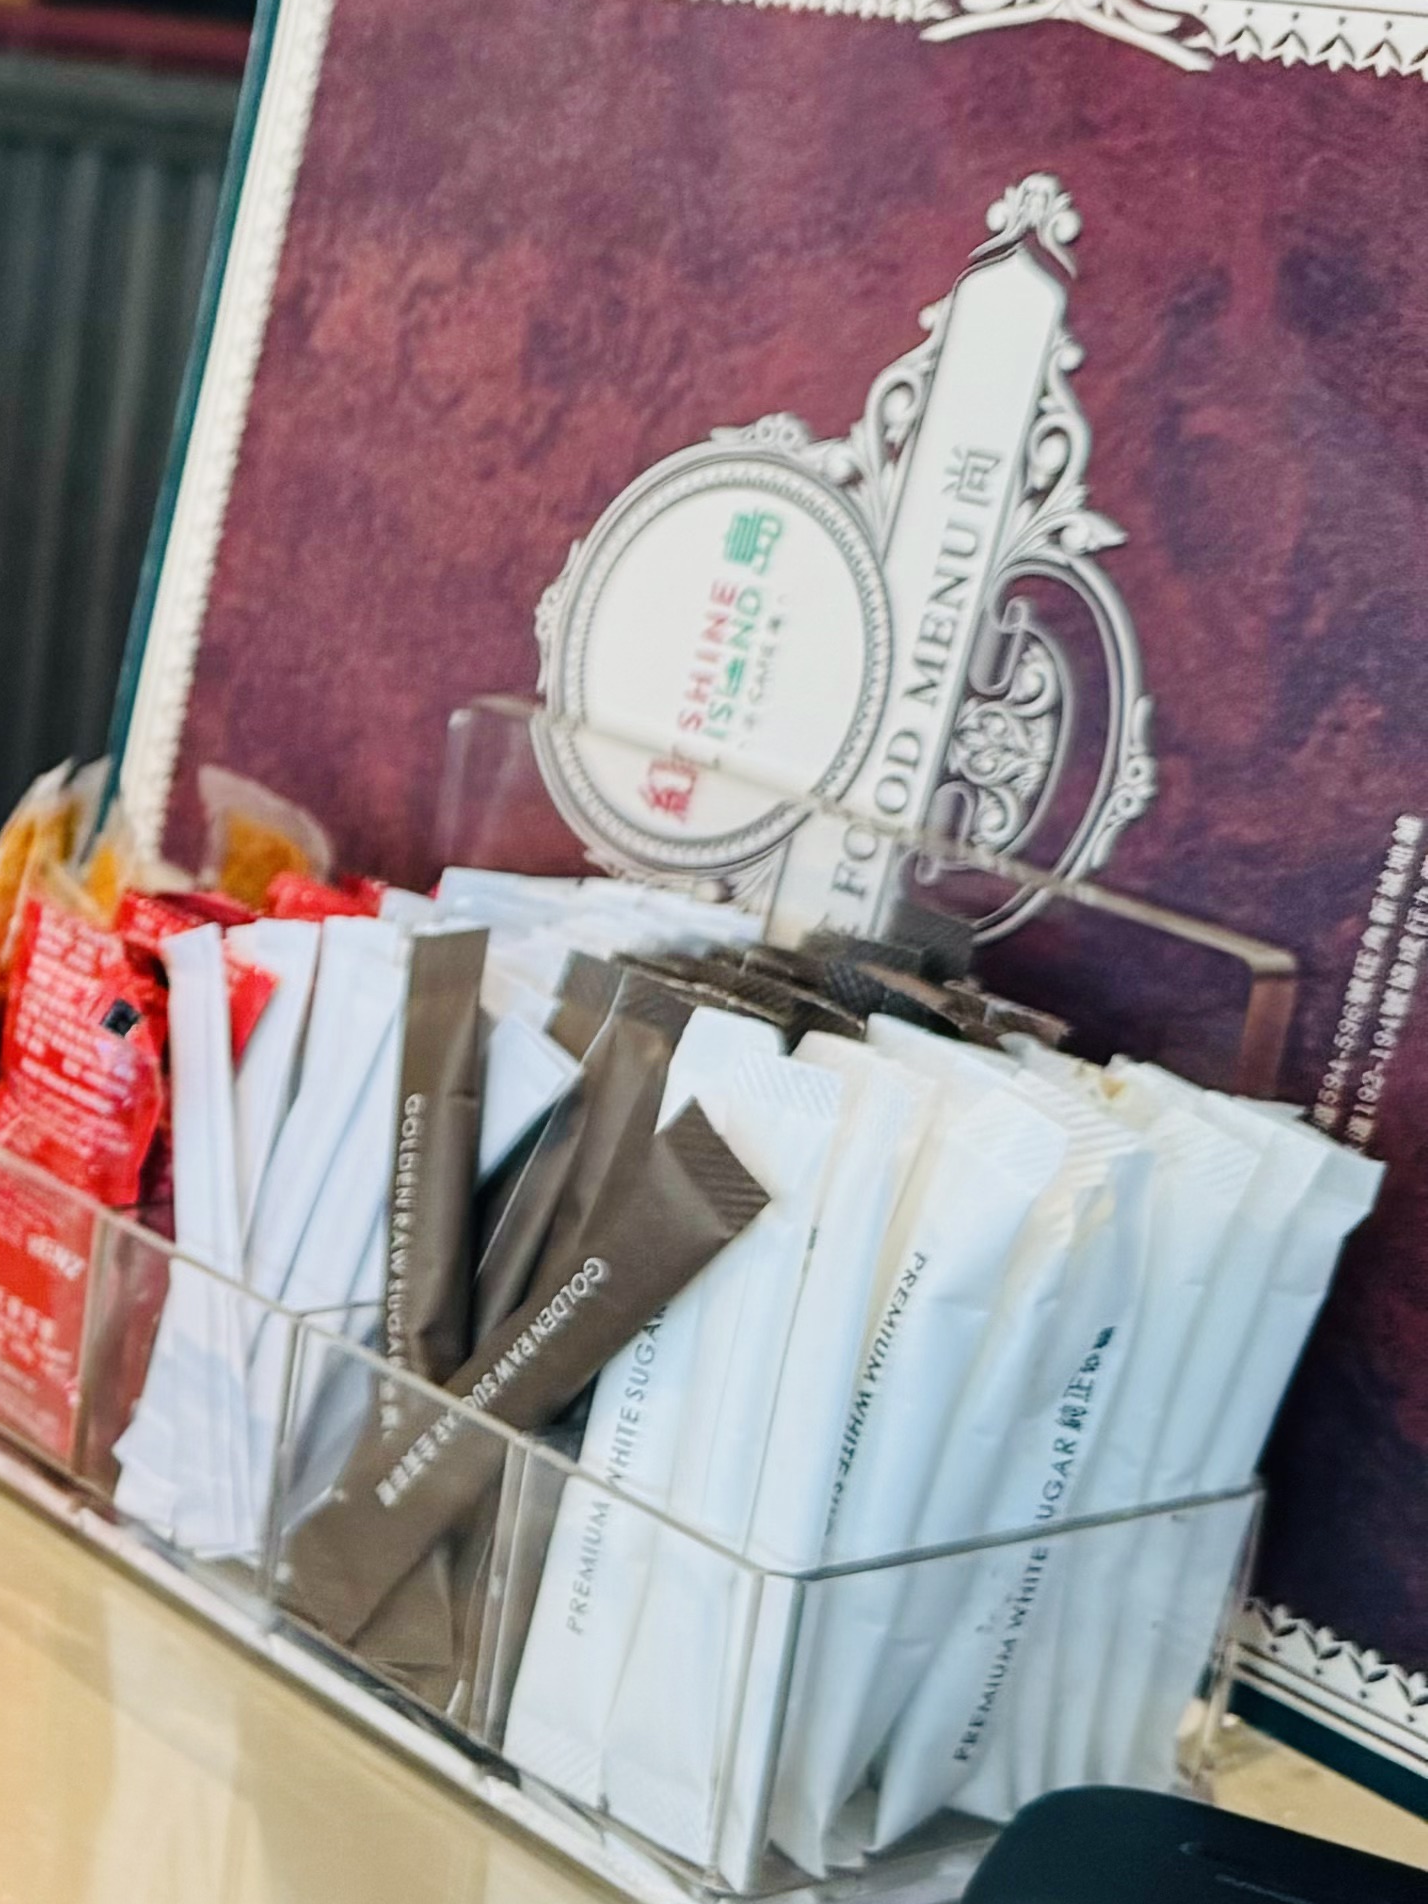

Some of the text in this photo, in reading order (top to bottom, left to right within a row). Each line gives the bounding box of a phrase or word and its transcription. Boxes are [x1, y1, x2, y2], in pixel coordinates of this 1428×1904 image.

[676, 580, 739, 732] SHINE
[831, 728, 924, 900] FOOD
[901, 520, 984, 712] MENU
[395, 1093, 425, 1209] GOLDEN
[390, 1211, 412, 1274] RAW
[529, 1255, 611, 1345] GOLDEN
[494, 1330, 536, 1386] RAW
[864, 1250, 928, 1386] PREMIUM
[834, 1389, 874, 1478] WHITE
[565, 1497, 612, 1635] PREMIUM
[952, 1637, 1019, 1763] PREMIUM
[1008, 1546, 1050, 1634] WHITE
[1035, 1436, 1079, 1524] UGAR
